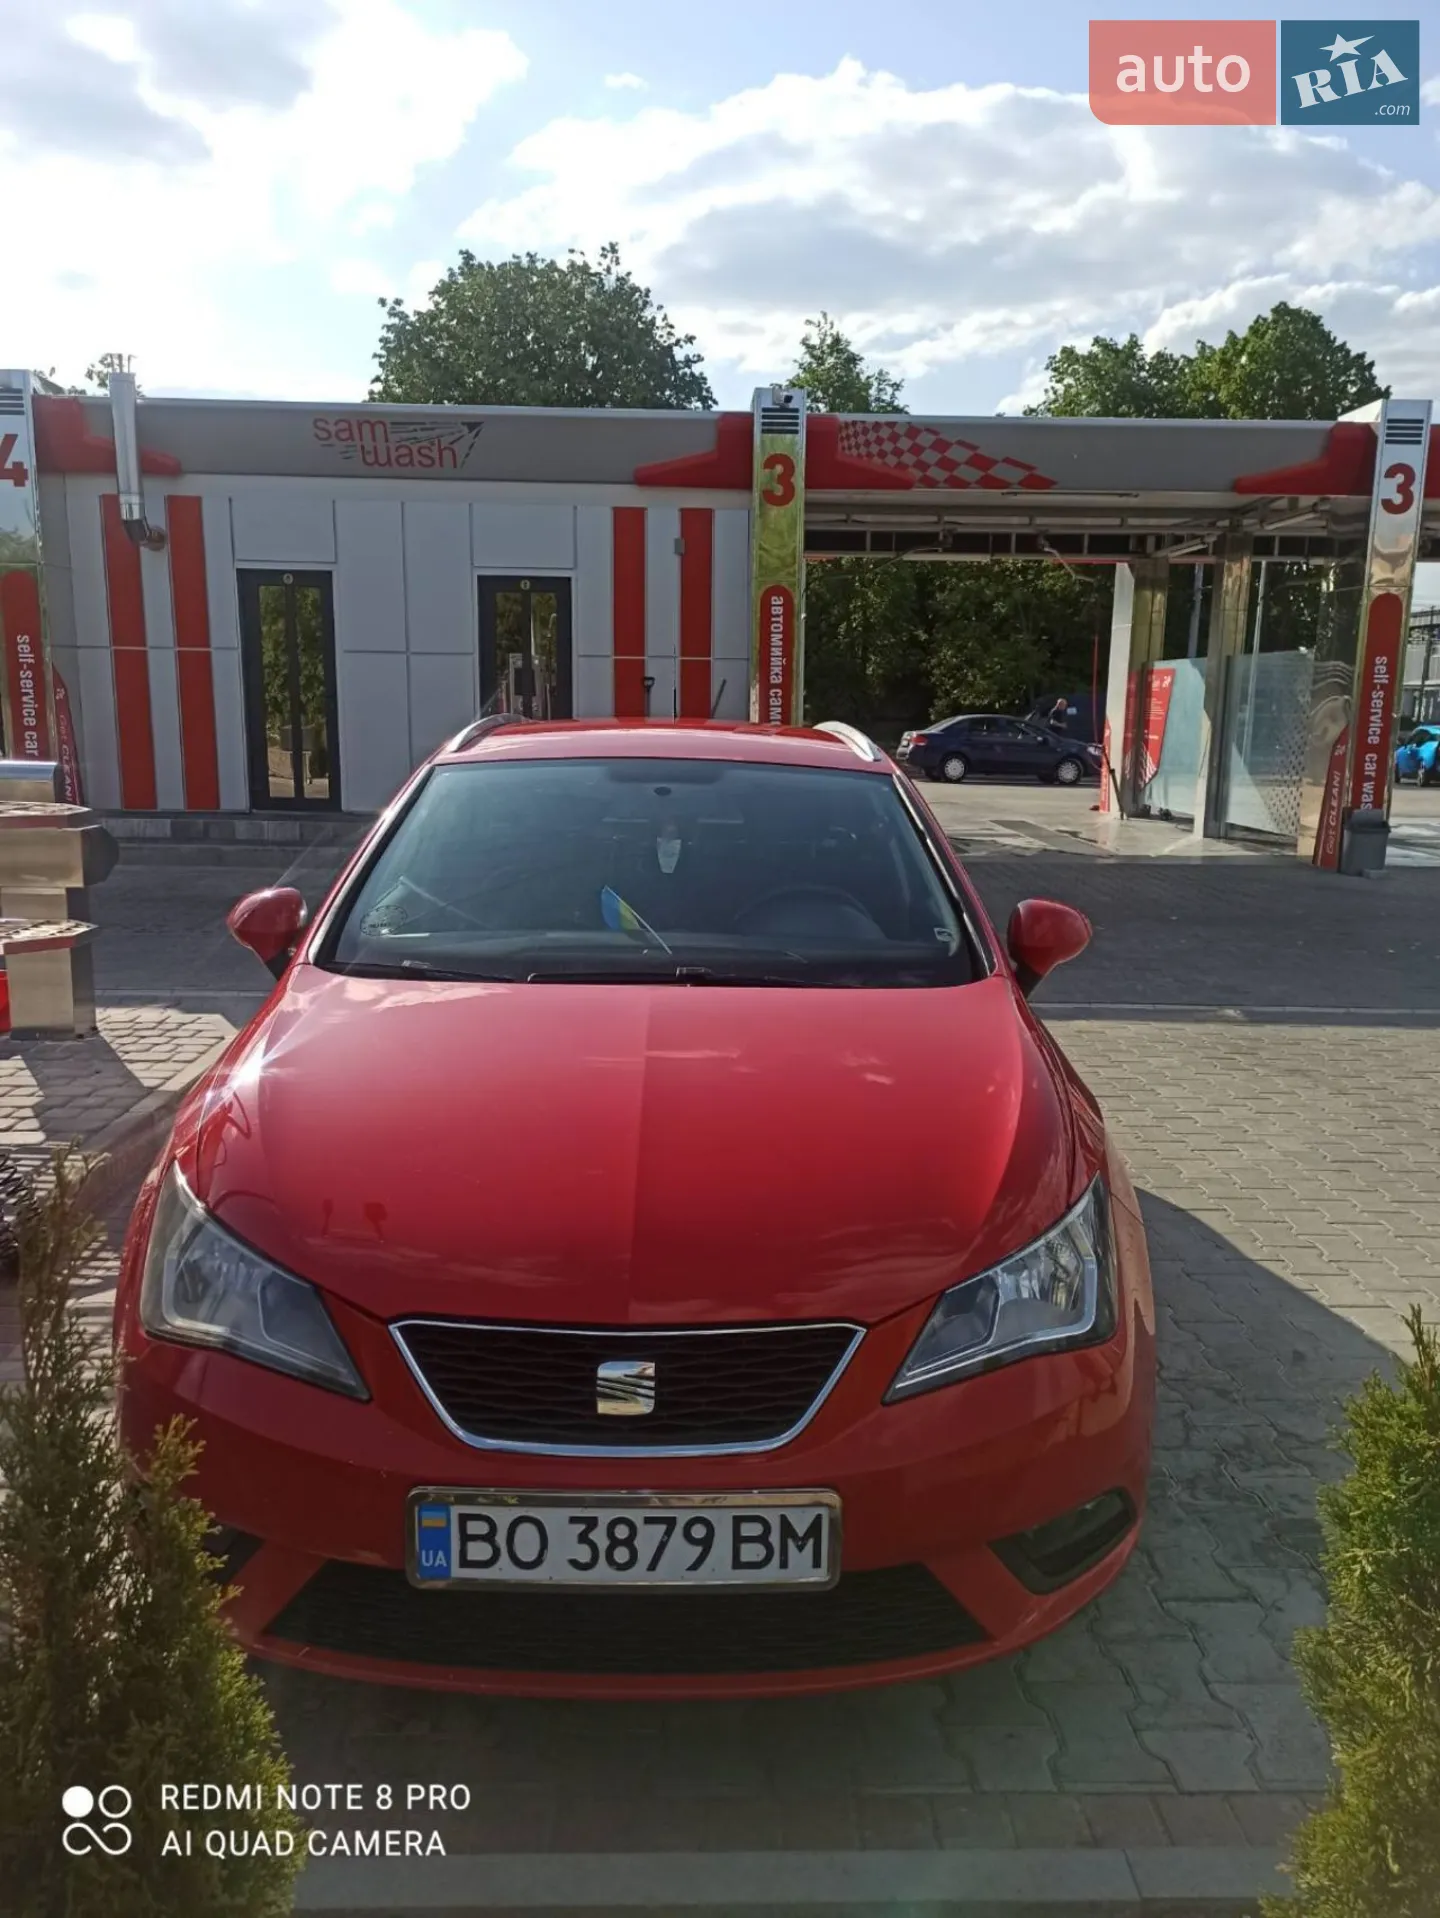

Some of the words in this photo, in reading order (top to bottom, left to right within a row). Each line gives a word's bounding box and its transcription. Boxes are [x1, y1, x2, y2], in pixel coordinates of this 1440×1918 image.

[312, 417, 390, 443] sam
[0, 433, 29, 487] 4
[360, 437, 458, 469] wash
[762, 453, 796, 507] 3
[1381, 462, 1417, 515] 3
[17, 634, 39, 726] self-service
[1367, 655, 1389, 745] self-service
[769, 688, 782, 725] сам
[24, 731, 38, 757] car
[1363, 752, 1378, 777] car
[1360, 780, 1375, 810] was
[421, 1549, 448, 1568] UA
[457, 1512, 549, 1570] BO
[567, 1514, 716, 1572] 3879
[731, 1513, 824, 1570] BM
